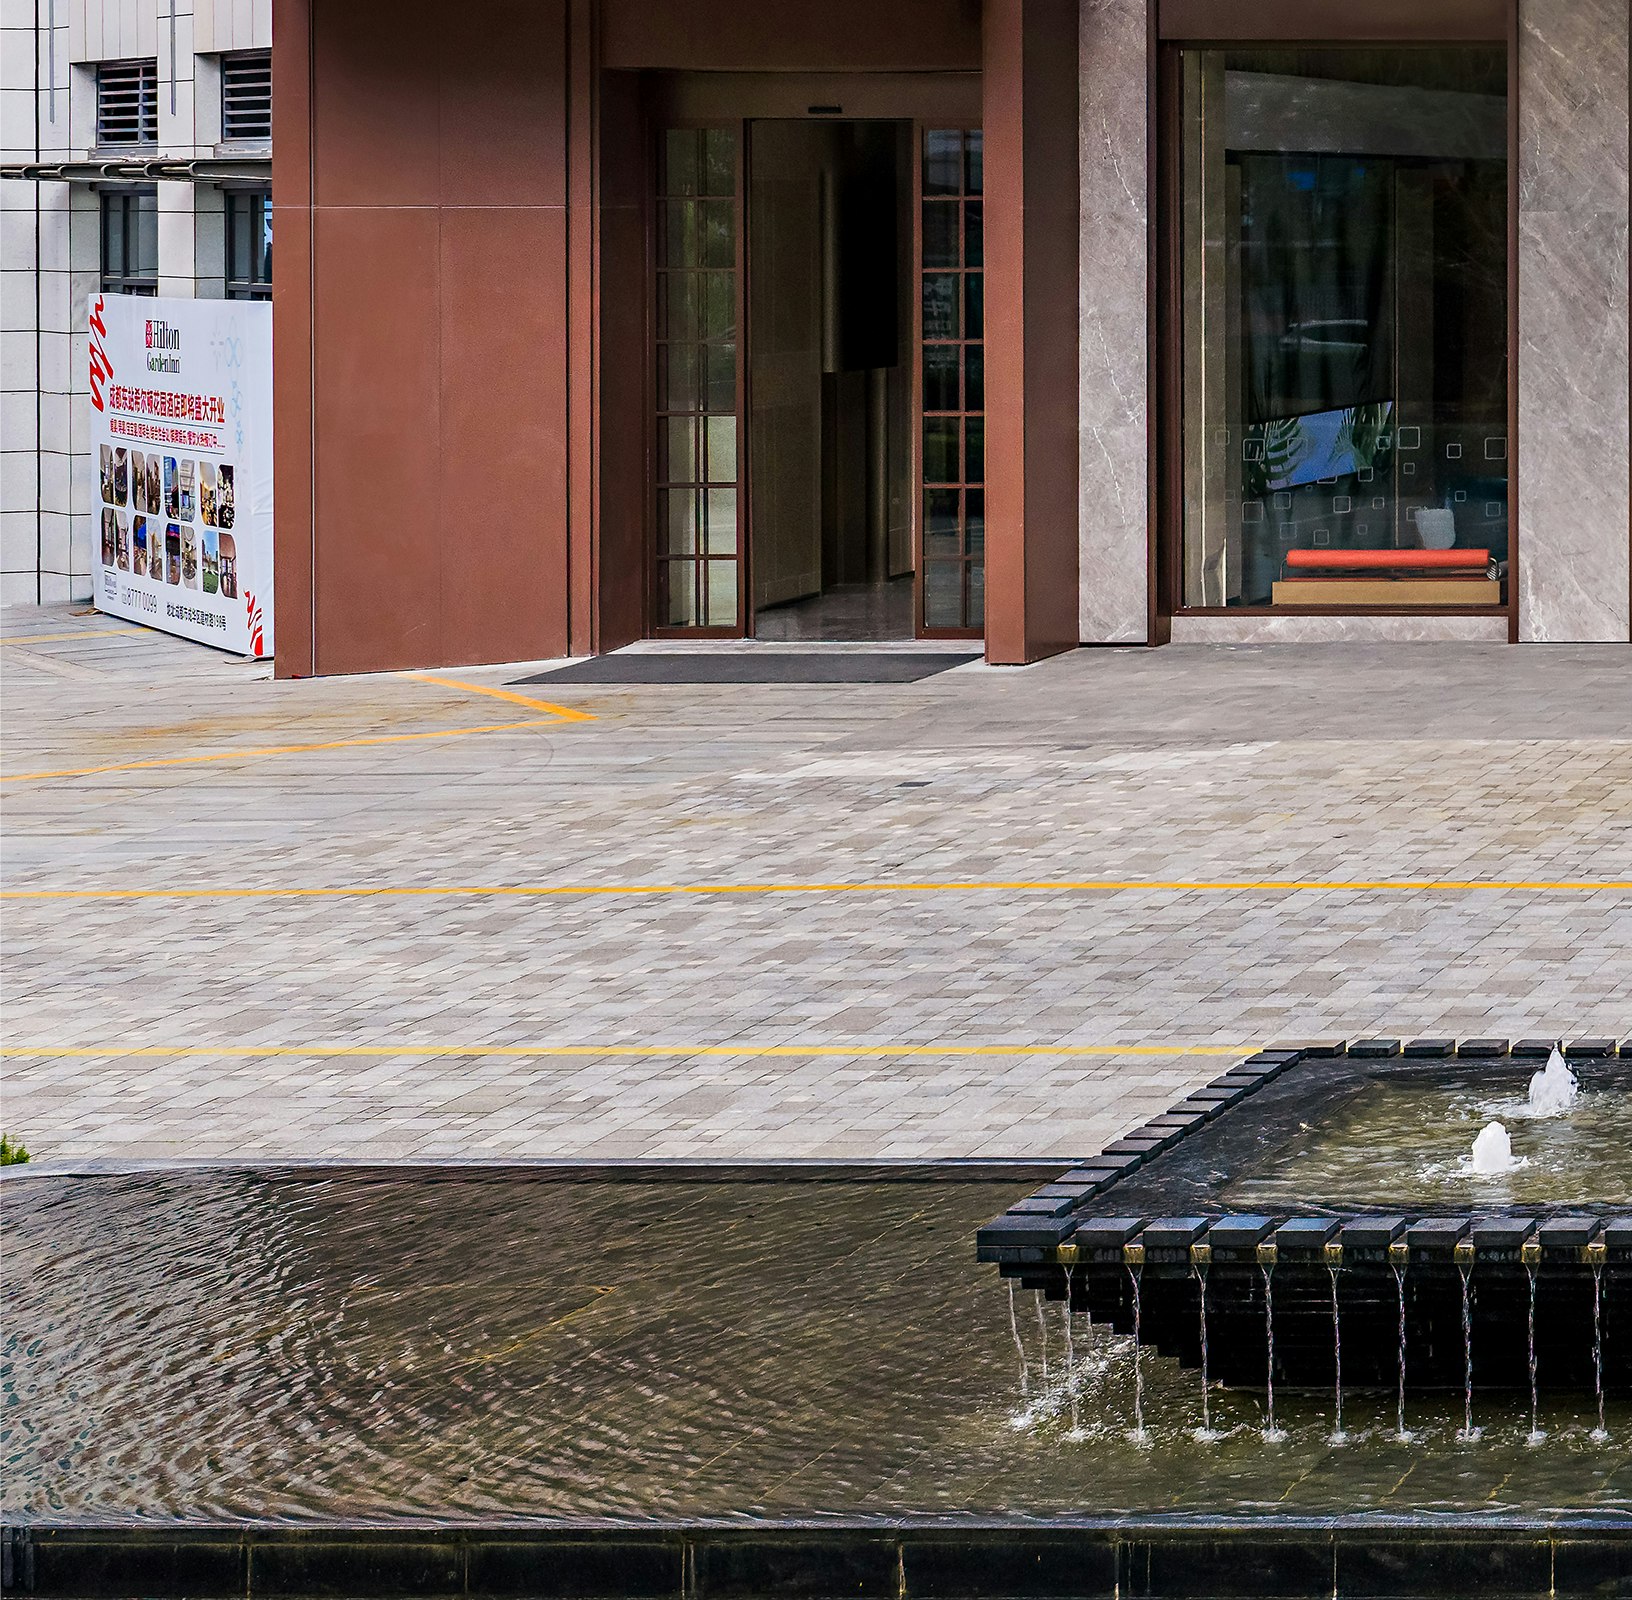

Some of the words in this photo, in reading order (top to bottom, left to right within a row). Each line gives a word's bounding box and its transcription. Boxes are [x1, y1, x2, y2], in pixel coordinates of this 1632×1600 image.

[153, 320, 180, 350] Hilton
[147, 352, 168, 373] Garden
[168, 355, 180, 373] Inn
